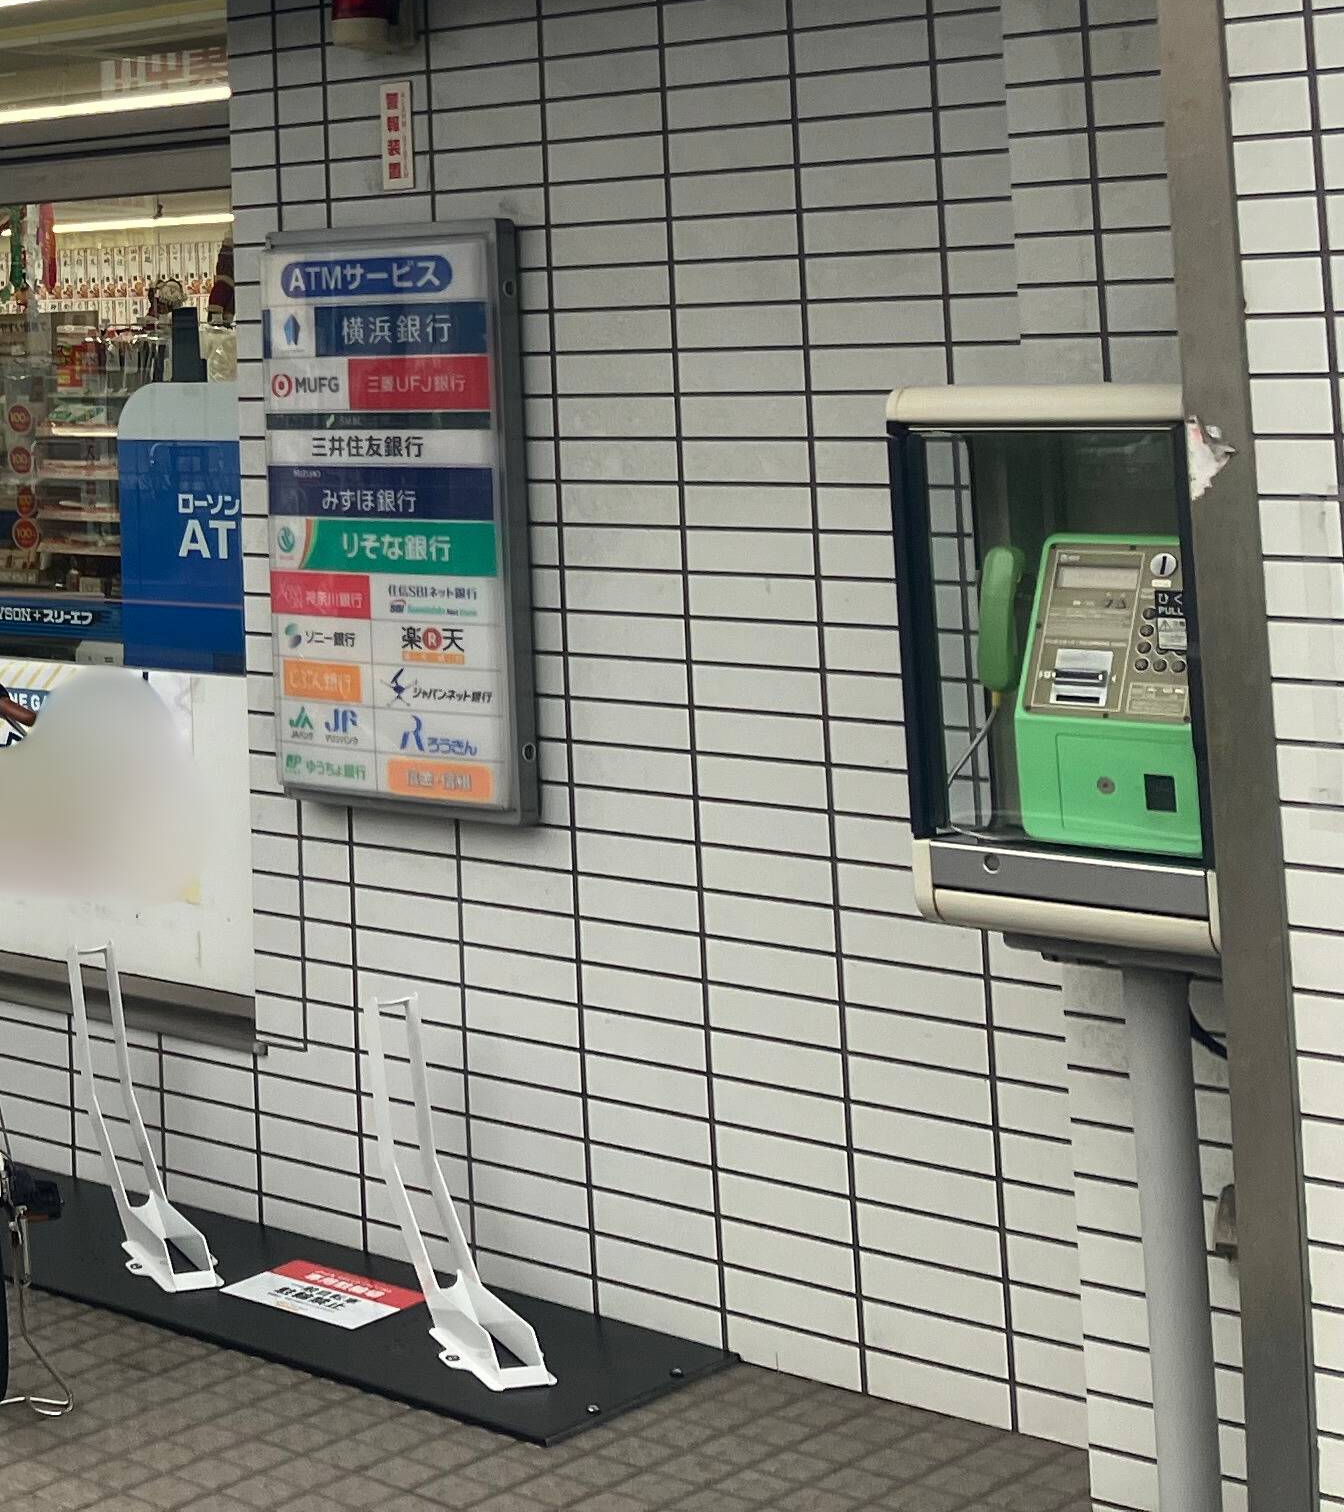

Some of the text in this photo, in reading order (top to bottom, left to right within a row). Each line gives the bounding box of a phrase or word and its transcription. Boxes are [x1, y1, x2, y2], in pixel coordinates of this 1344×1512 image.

[288, 260, 441, 292] ATMサービス
[341, 313, 453, 345] 横浜銀行
[294, 374, 467, 394] MUFG 三菱UFJ銀行
[311, 435, 424, 458] 三井住友銀行
[177, 493, 240, 516] ローソン
[321, 489, 417, 513] みずほ銀行
[341, 531, 451, 562] りそな銀行
[43, 608, 93, 626] スリーエフ
[304, 630, 356, 648] ソニー銀行
[413, 686, 493, 704] ジャパンネット銀行
[427, 737, 478, 757] ろうきん
[305, 759, 367, 780] ゆうちょ銀行
